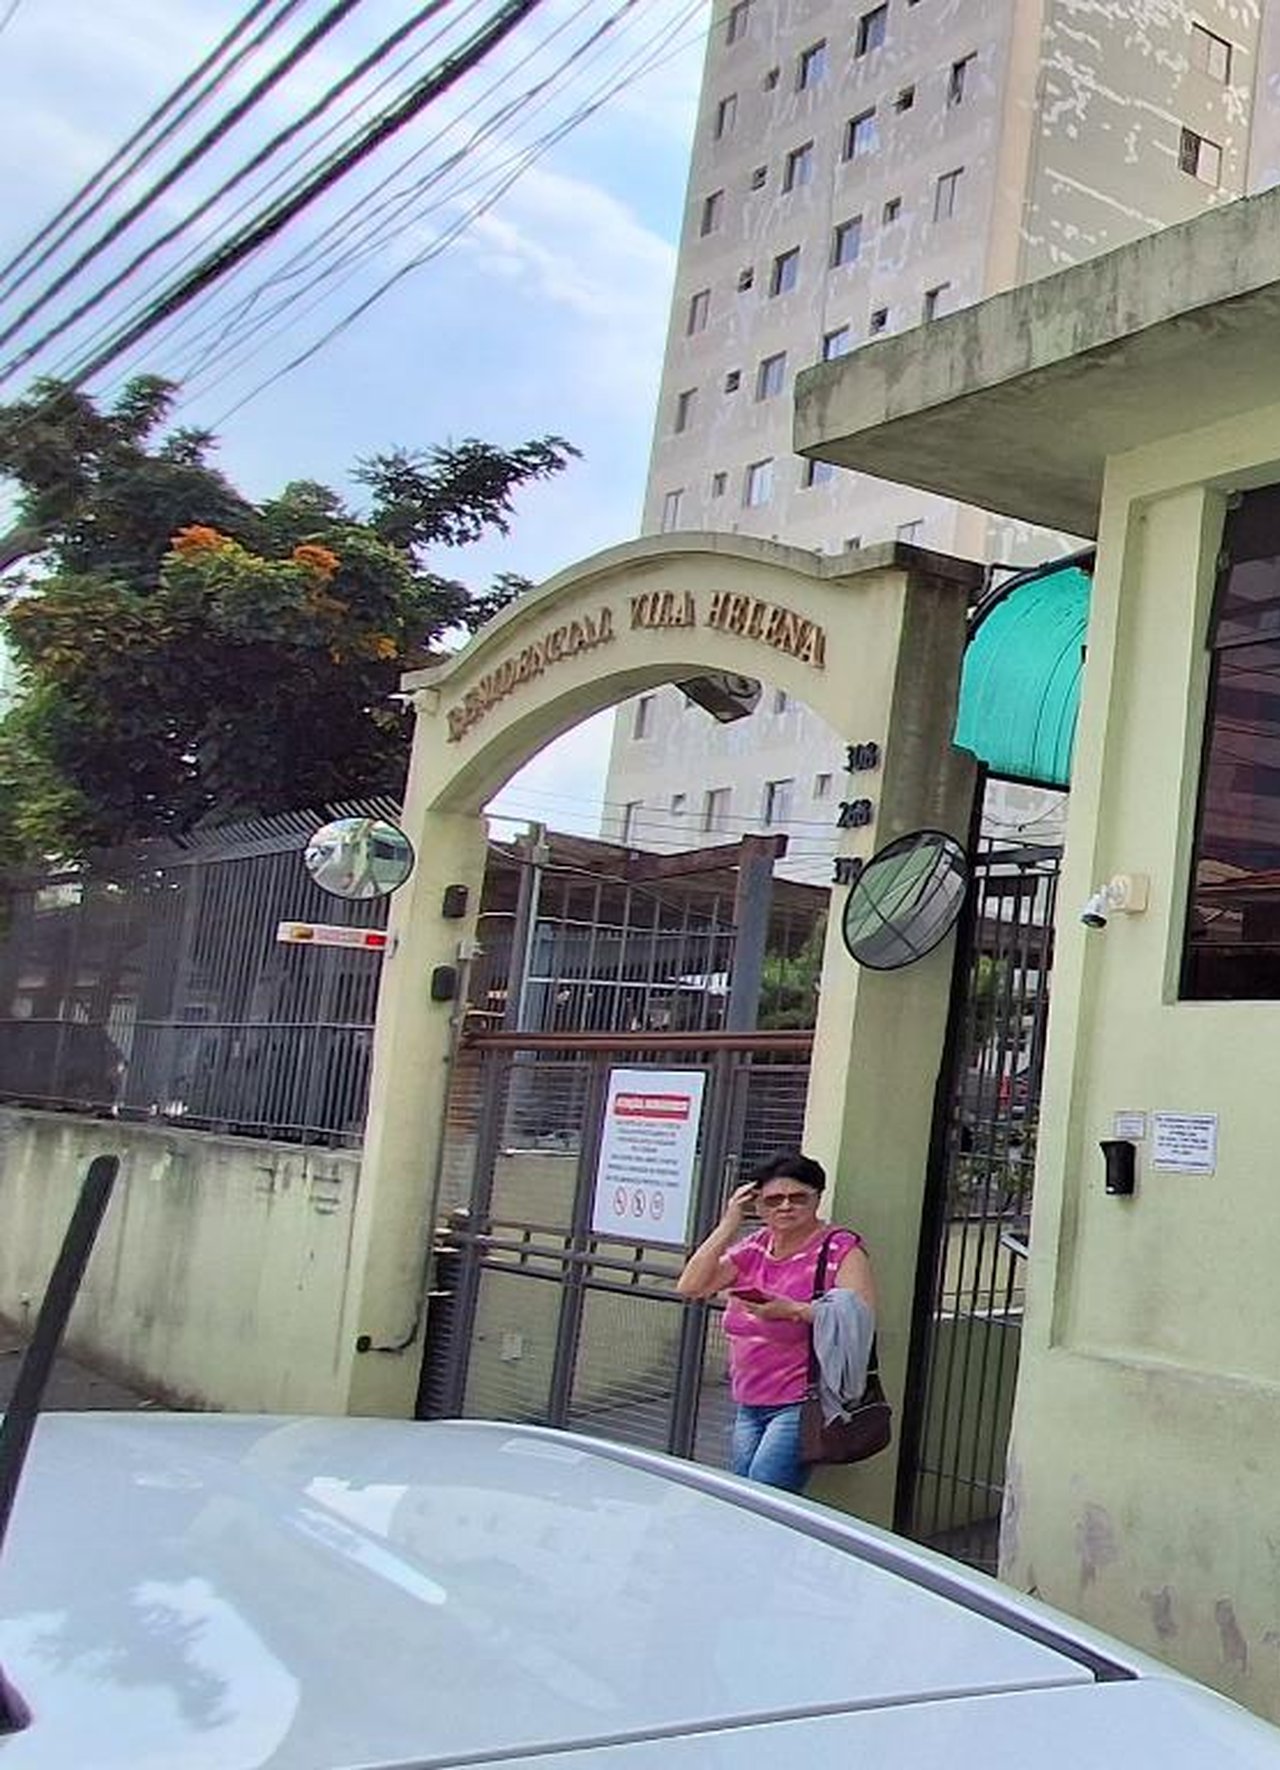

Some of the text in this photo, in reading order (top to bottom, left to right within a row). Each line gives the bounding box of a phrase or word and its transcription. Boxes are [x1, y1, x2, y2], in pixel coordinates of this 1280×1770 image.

[446, 590, 827, 743] RESIDENCIAL VILA HELENA
